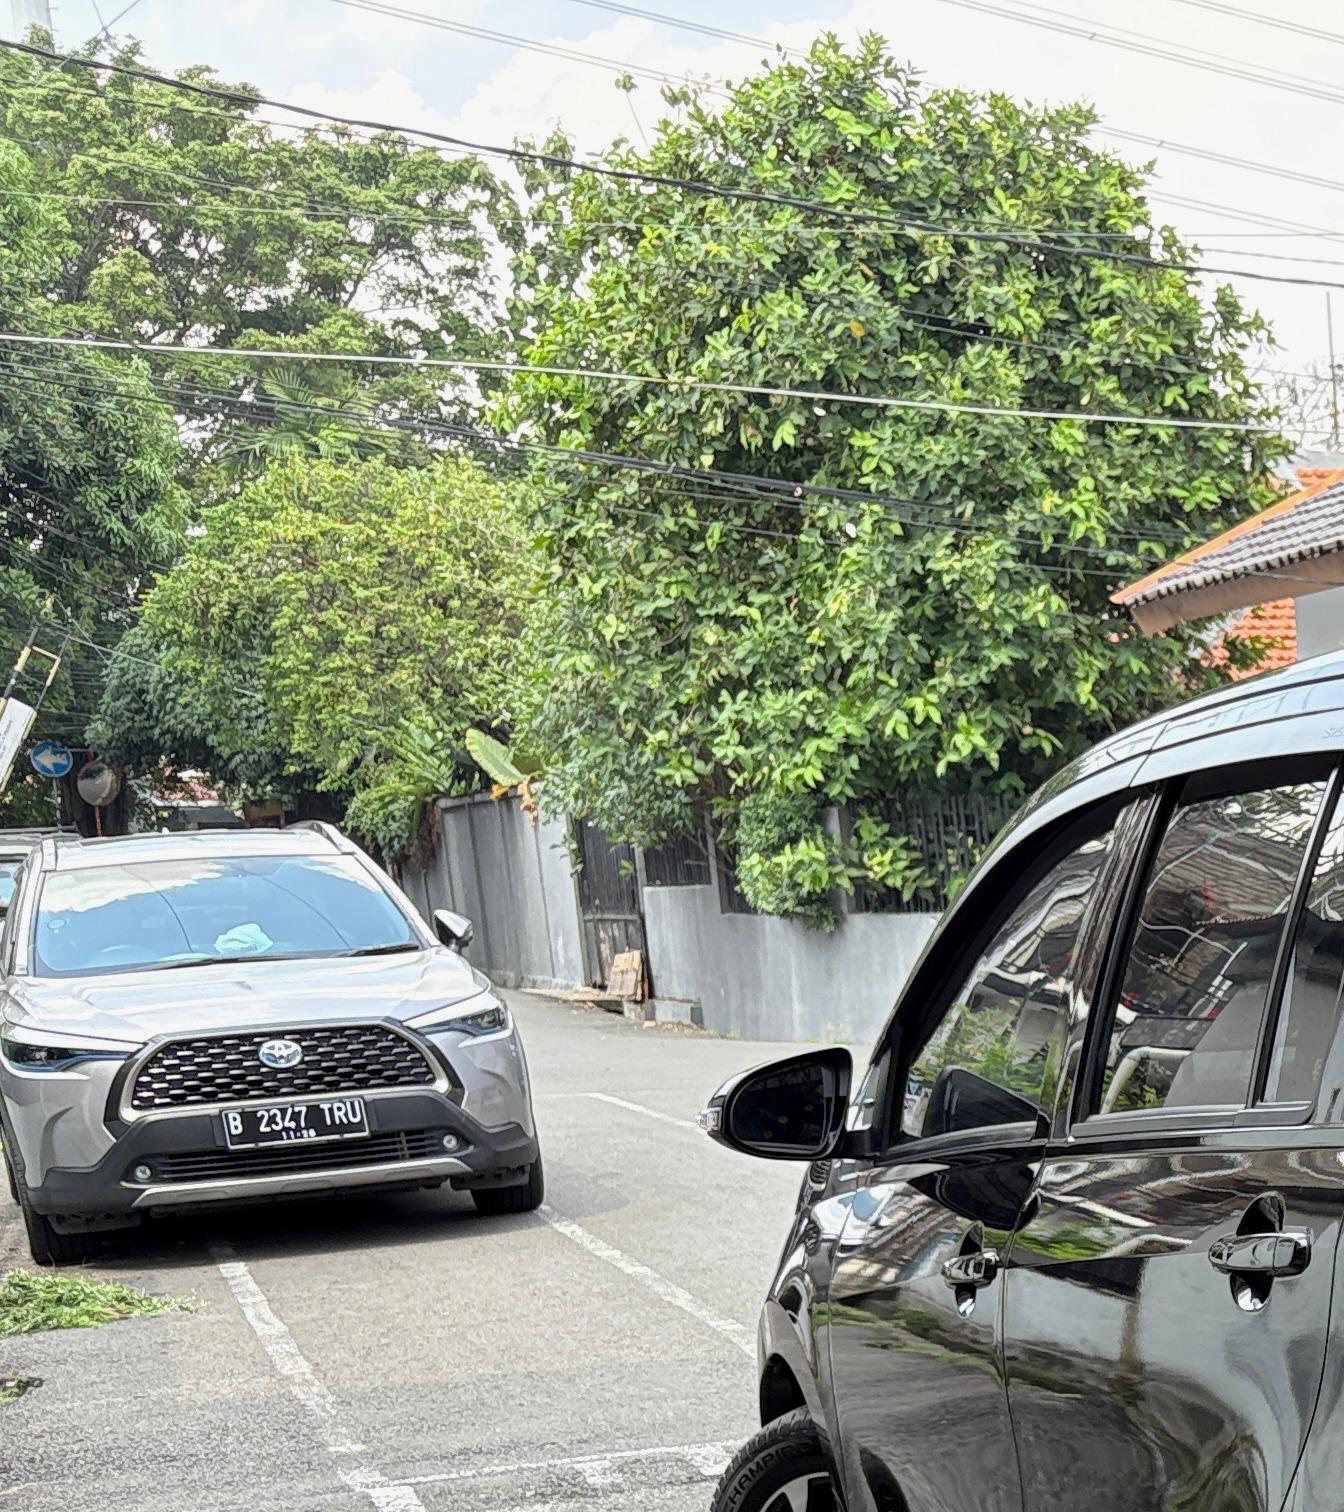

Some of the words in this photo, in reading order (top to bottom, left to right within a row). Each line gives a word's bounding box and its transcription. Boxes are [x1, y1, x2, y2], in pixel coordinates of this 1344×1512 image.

[227, 1112, 243, 1135] B
[257, 1106, 308, 1133] 2347
[320, 1100, 362, 1126] TRU
